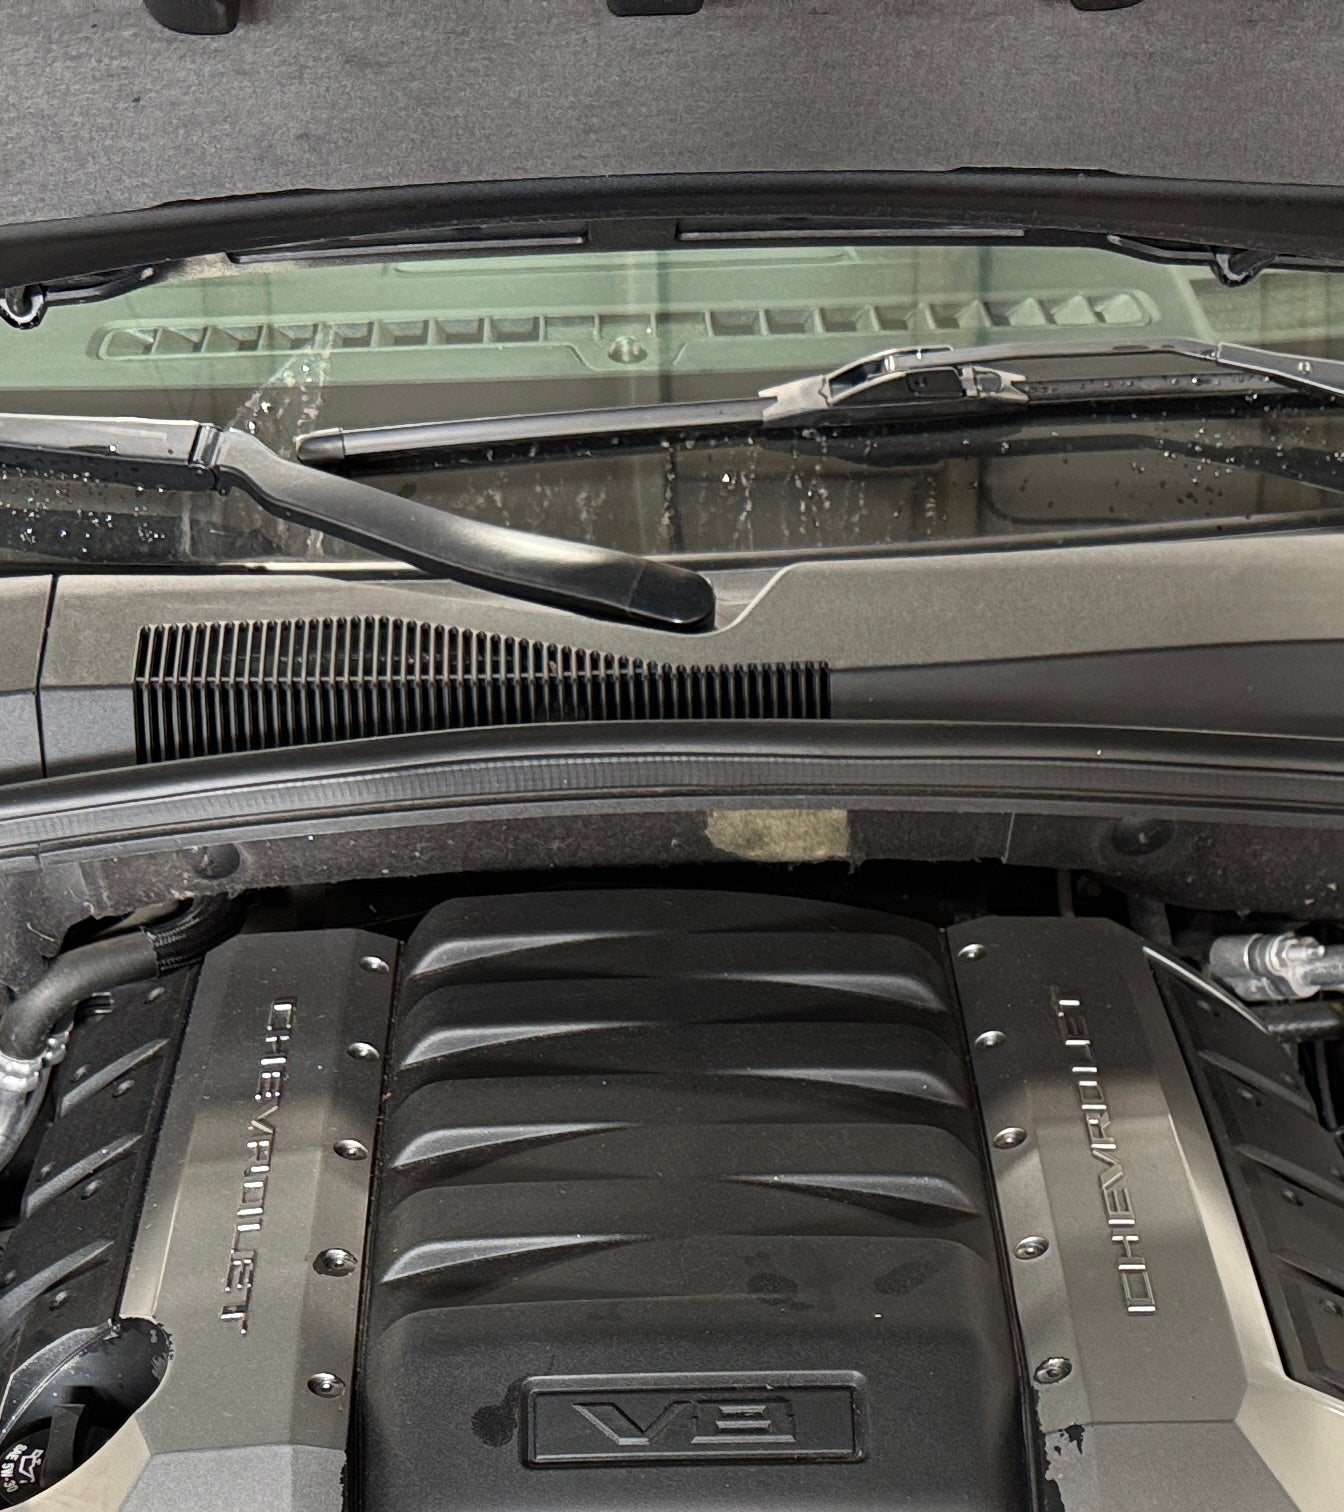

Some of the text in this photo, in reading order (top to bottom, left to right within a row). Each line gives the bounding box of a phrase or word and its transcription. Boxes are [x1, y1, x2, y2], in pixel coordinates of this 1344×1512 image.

[219, 996, 298, 1336] CHEVROLET
[1049, 985, 1158, 1316] CHEVROLET
[4, 1443, 27, 1461] SAE
[570, 1396, 797, 1446] V8
